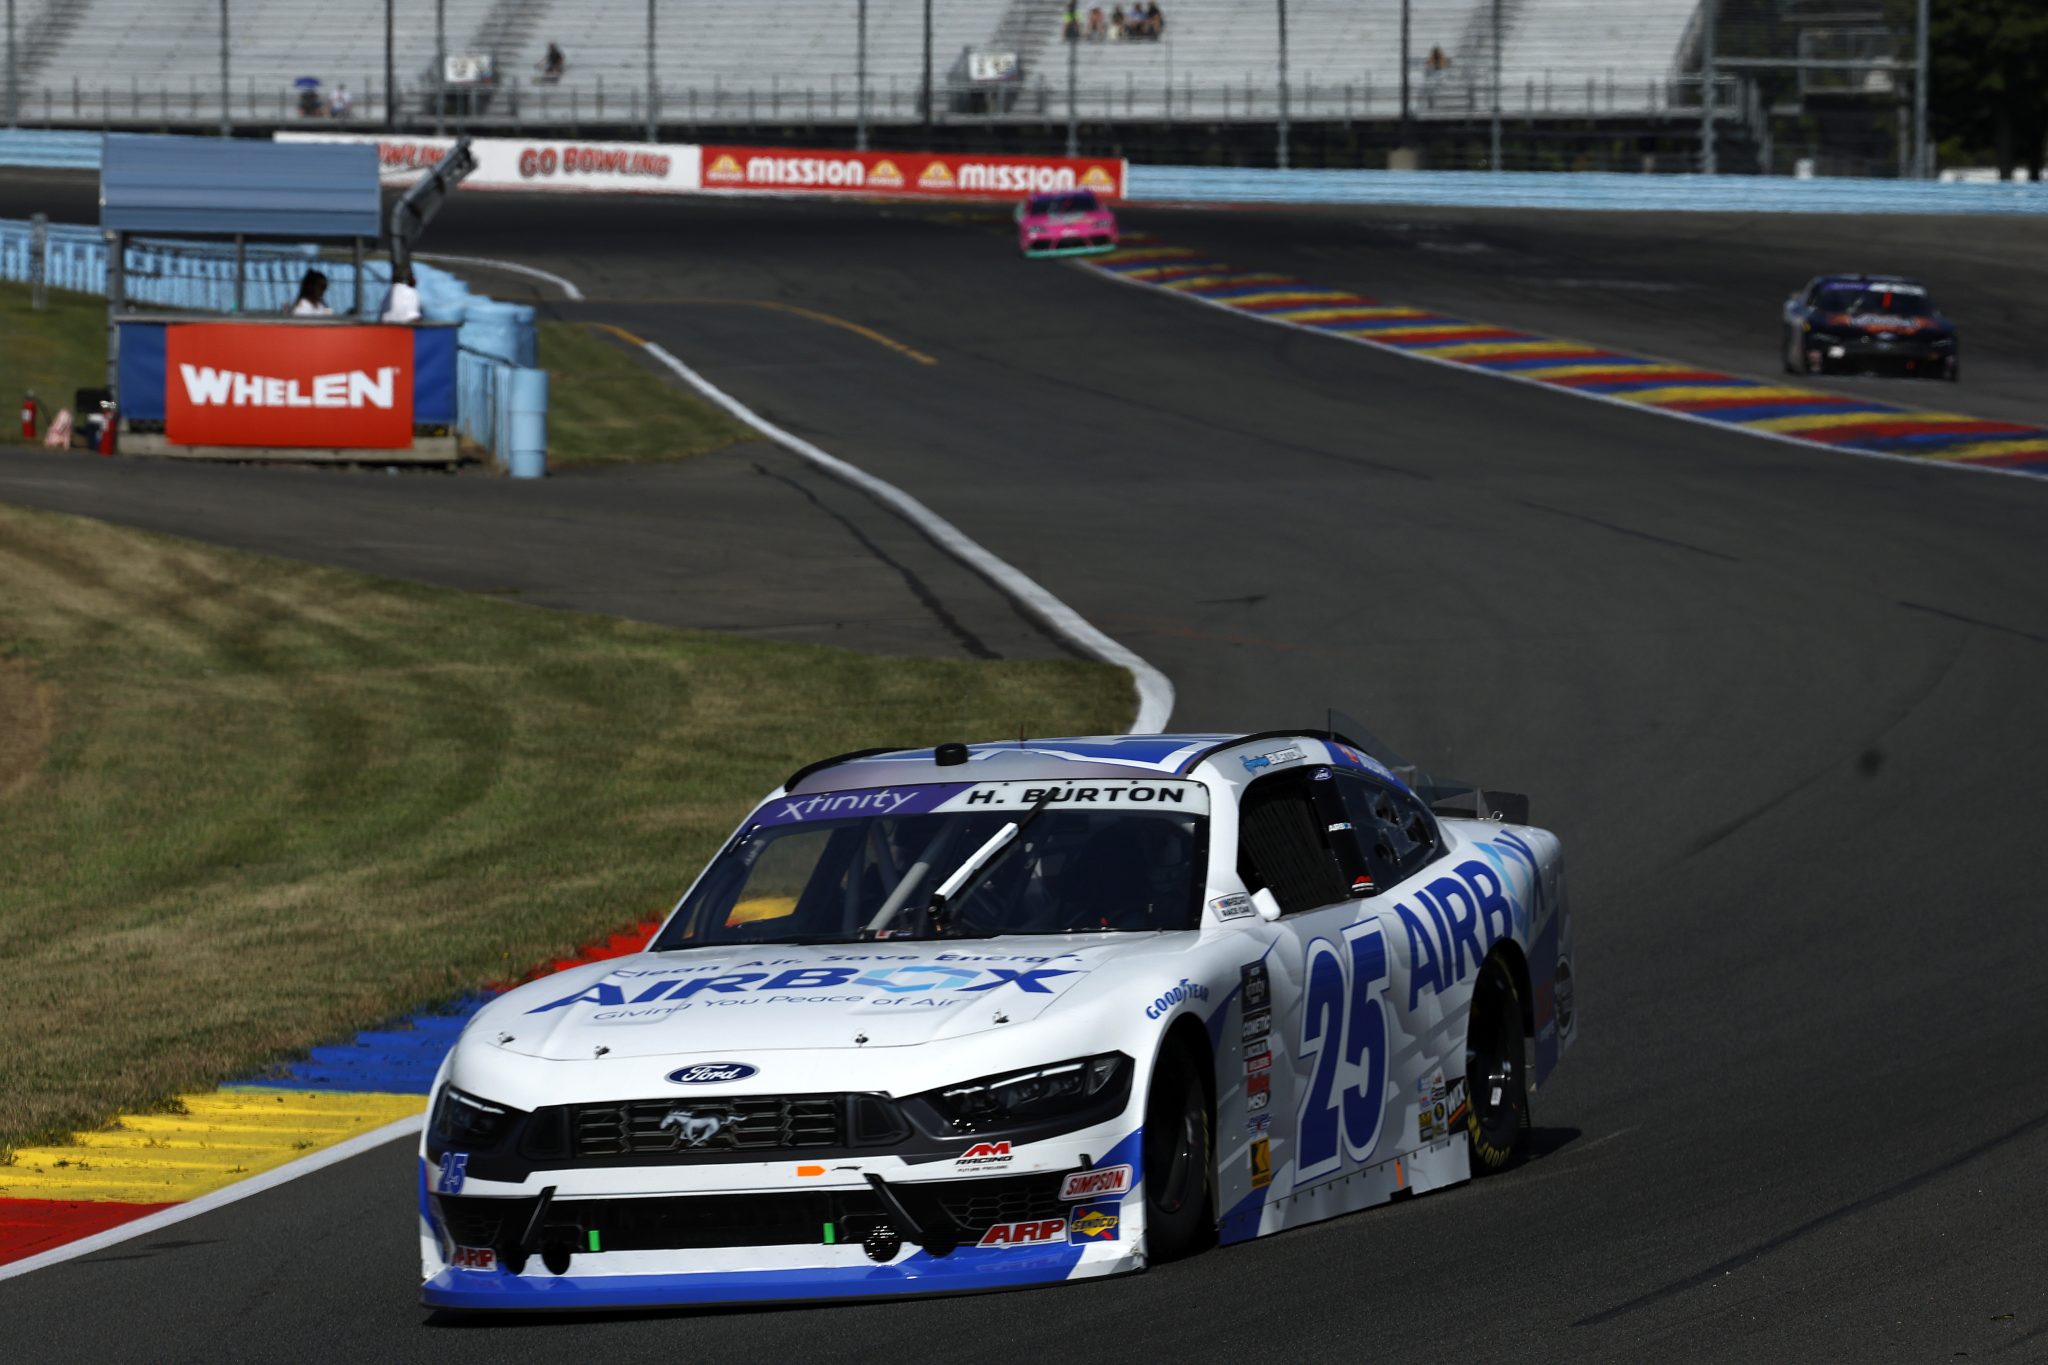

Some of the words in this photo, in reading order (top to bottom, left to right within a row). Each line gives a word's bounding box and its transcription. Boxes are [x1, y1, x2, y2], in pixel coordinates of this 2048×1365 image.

[519, 147, 558, 178] GO
[562, 146, 672, 177] BOWLING
[746, 157, 865, 185] MISSION
[957, 162, 1077, 191] MISSION
[180, 362, 394, 409] WHELEN
[966, 789, 1005, 804] H.
[1020, 786, 1185, 803] BURTON
[611, 965, 720, 978] Clean
[821, 953, 920, 962] Save
[524, 965, 1081, 1015] AIRBOX
[593, 1001, 693, 1020] Giving
[705, 997, 760, 1007] You
[766, 994, 864, 1004] Peace
[872, 996, 911, 1006] of
[1293, 916, 1392, 1188] 25
[681, 1064, 742, 1082] Ford
[955, 1155, 1015, 1166] RACING
[960, 1142, 1011, 1159] AM
[439, 1151, 469, 1195] 25
[1065, 1170, 1126, 1196] SIMPSON
[981, 1219, 1066, 1244] ARP
[1072, 1216, 1118, 1231] SUNOCO
[452, 1246, 493, 1267] ARP
